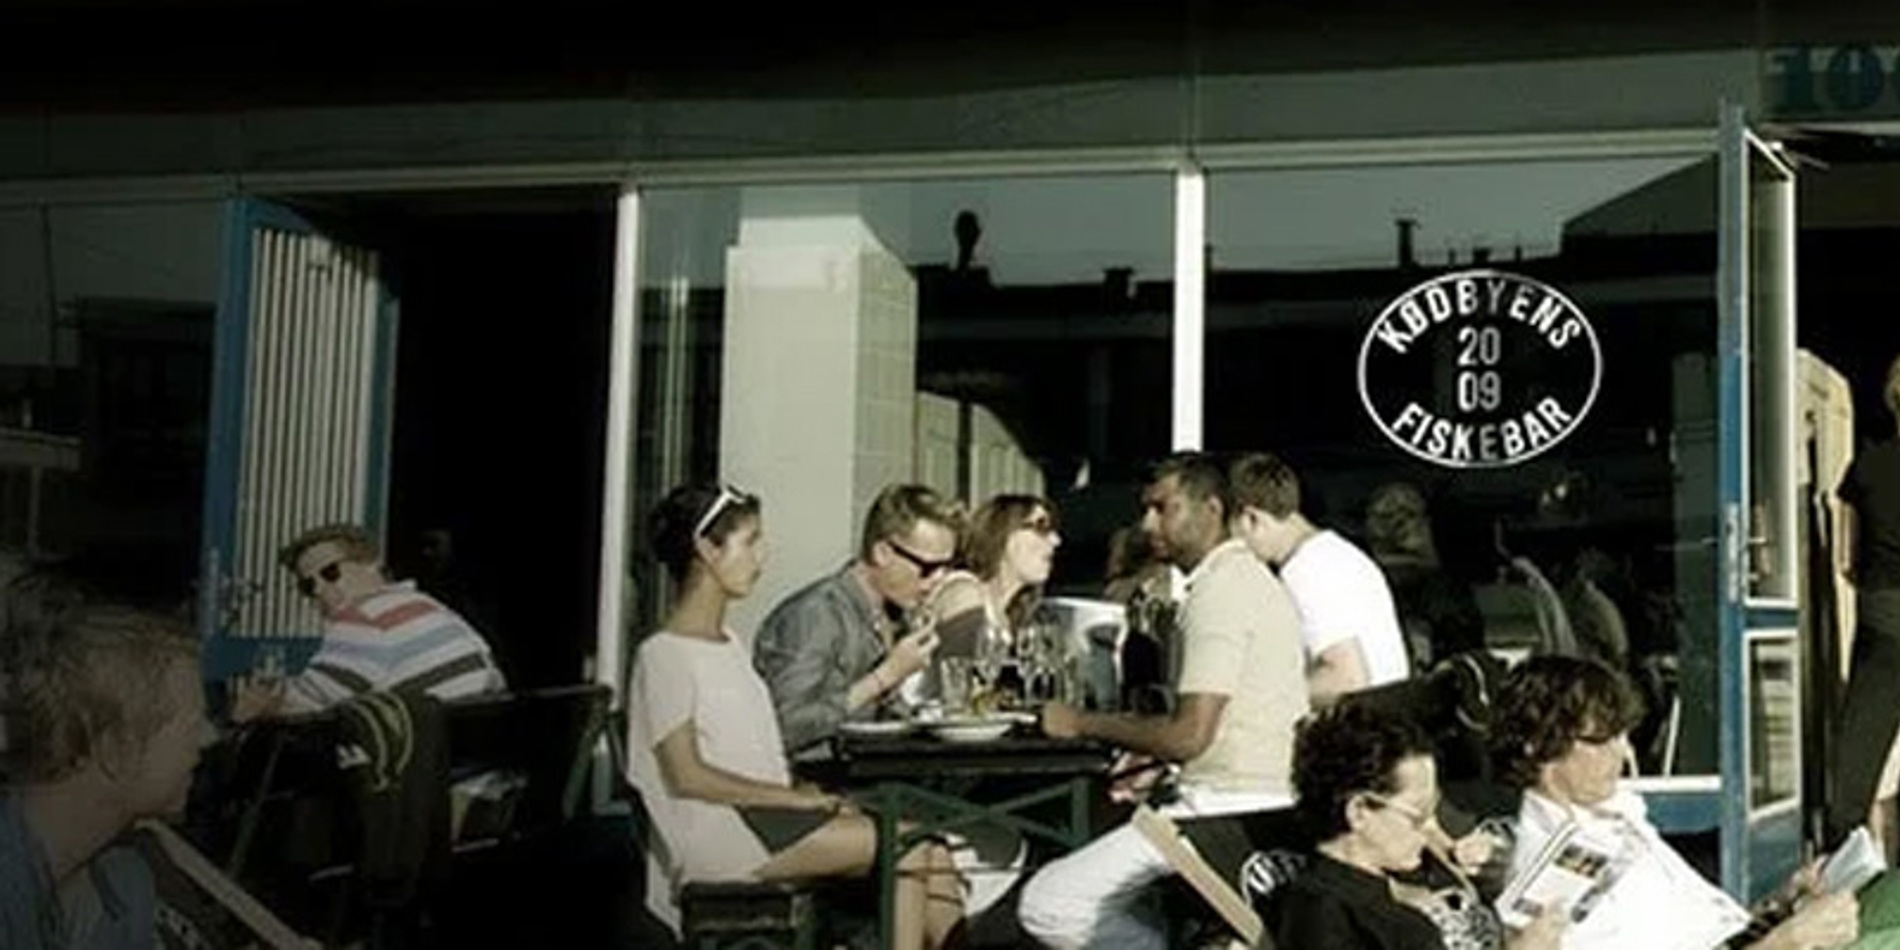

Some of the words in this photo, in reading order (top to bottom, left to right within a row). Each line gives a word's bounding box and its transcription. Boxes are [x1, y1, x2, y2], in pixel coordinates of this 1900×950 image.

[1376, 278, 1582, 353] KØDBYENS
[1457, 326, 1501, 366] 20
[1457, 370, 1501, 412] 09
[1391, 398, 1573, 462] FISKEBAR
